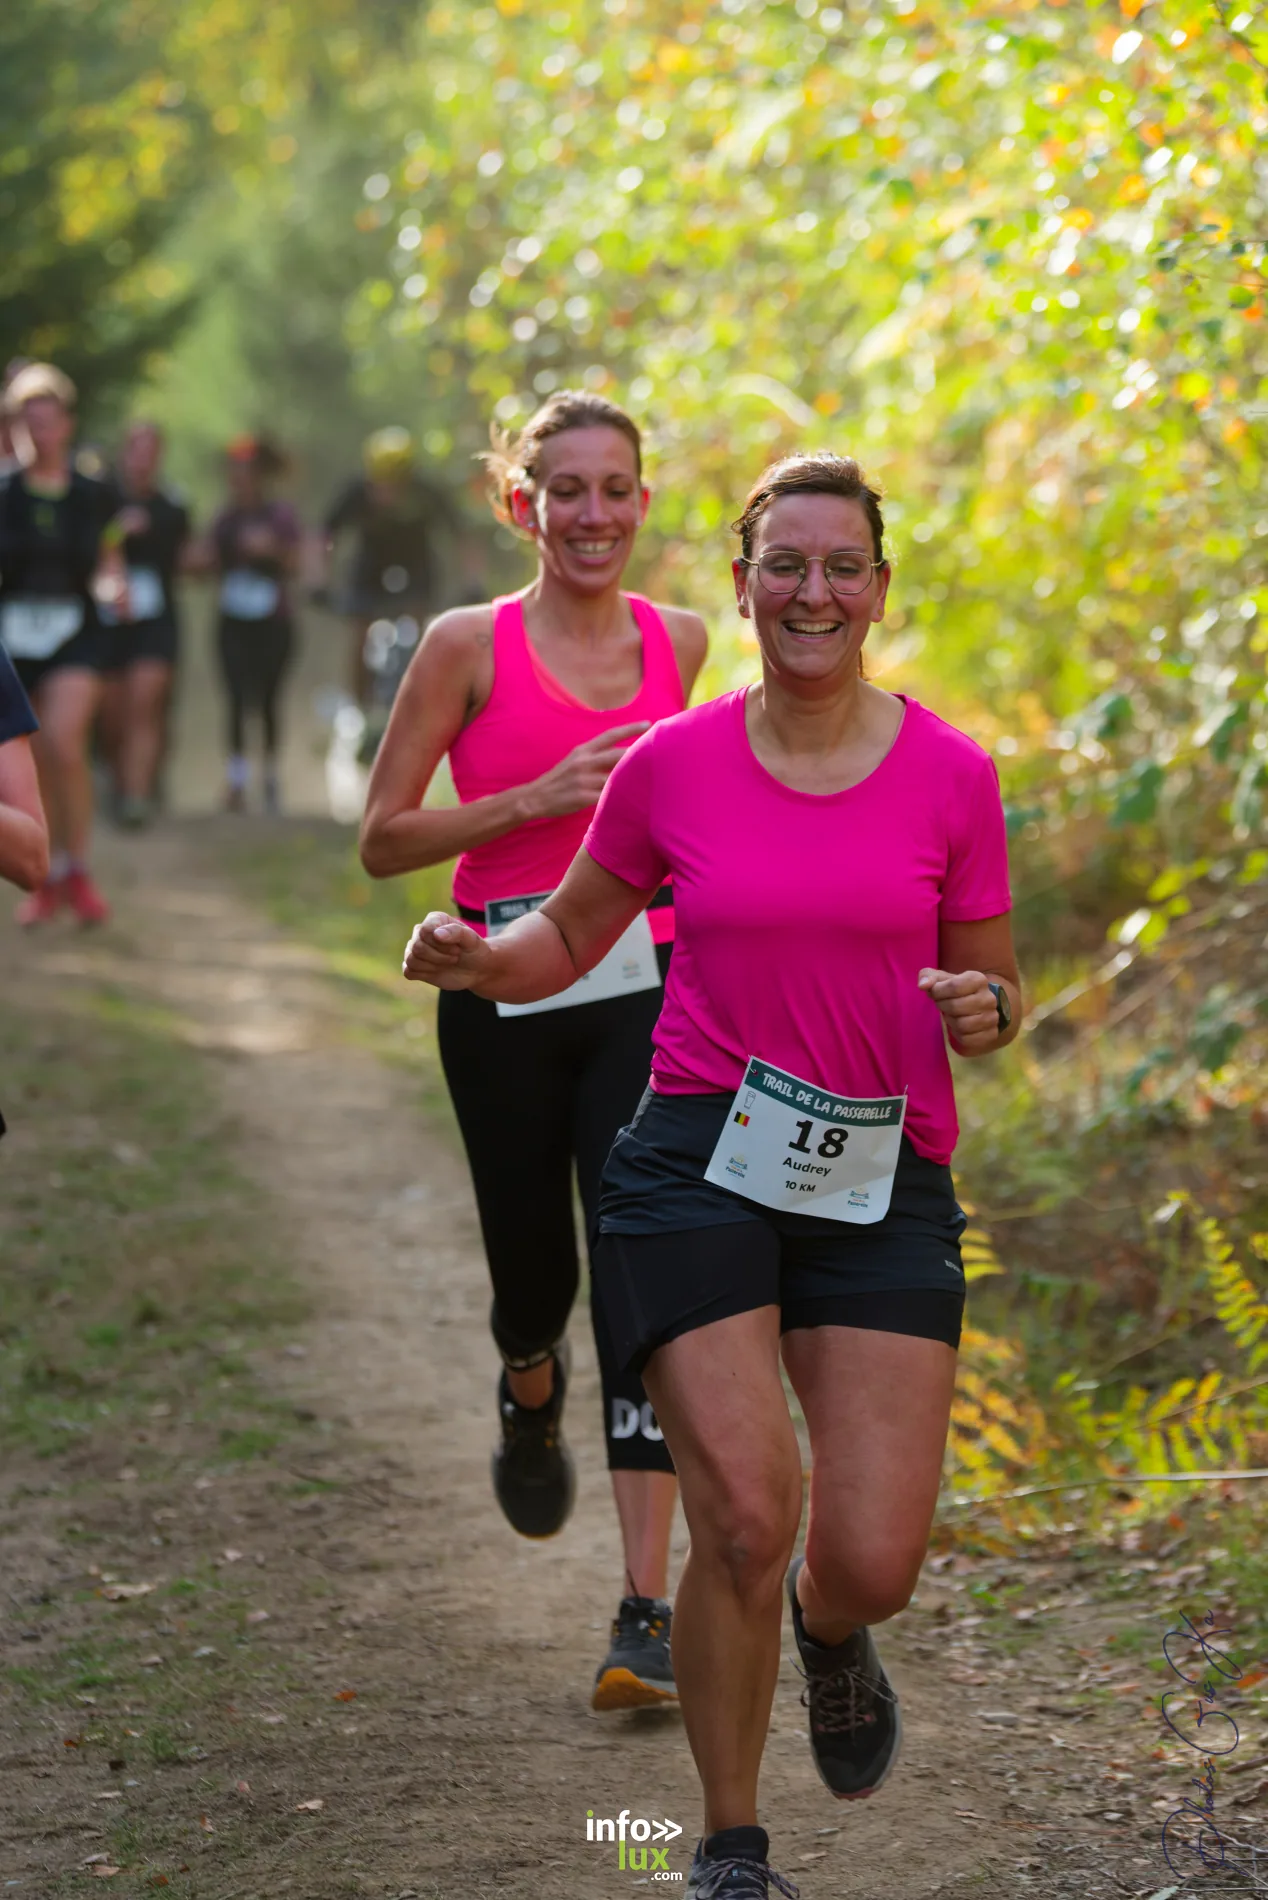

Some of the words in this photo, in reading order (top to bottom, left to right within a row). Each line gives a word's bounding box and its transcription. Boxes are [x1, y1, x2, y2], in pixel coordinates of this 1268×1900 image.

[762, 1072, 794, 1098] TRAIL
[795, 1090, 812, 1106] DE
[813, 1098, 830, 1113] LA
[832, 1104, 891, 1120] PASSERELLE
[788, 1119, 849, 1159] 18
[782, 1157, 832, 1177] Audrey
[785, 1180, 797, 1190] 10
[799, 1183, 816, 1193] KM
